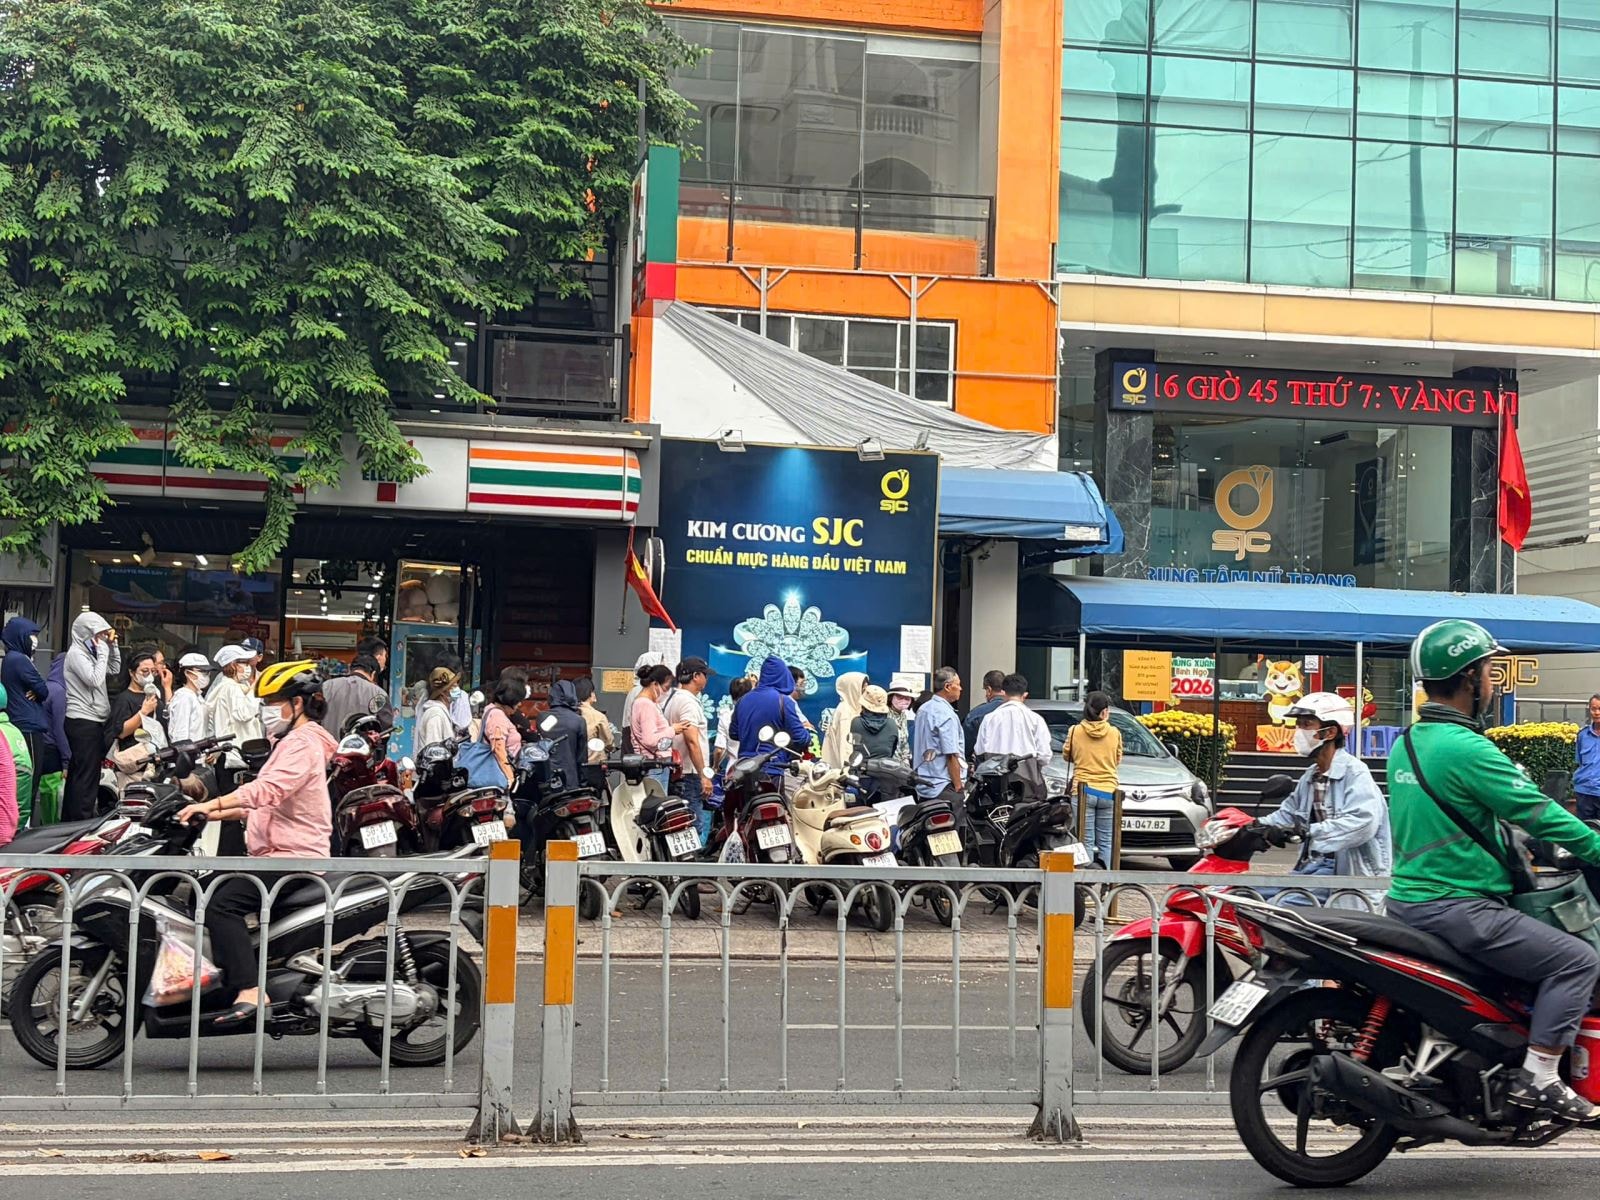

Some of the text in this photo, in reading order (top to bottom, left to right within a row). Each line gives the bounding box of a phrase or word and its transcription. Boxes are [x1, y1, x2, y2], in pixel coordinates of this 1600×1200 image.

[1186, 370, 1243, 401] GIỜ
[1248, 379, 1278, 404] 45
[1287, 376, 1353, 407] THỨ
[1359, 384, 1381, 409] 7:
[1388, 380, 1477, 413] VÀNG
[687, 517, 864, 547] KIM CƯƠNG SJC
[686, 546, 906, 574] CHUẨN MỰC HÀNG ĐẦU VIỆT NAM
[1147, 567, 1199, 583] RUNG
[1202, 565, 1248, 583] TÂM
[1447, 634, 1480, 657] Grab
[1171, 678, 1213, 695] 2026
